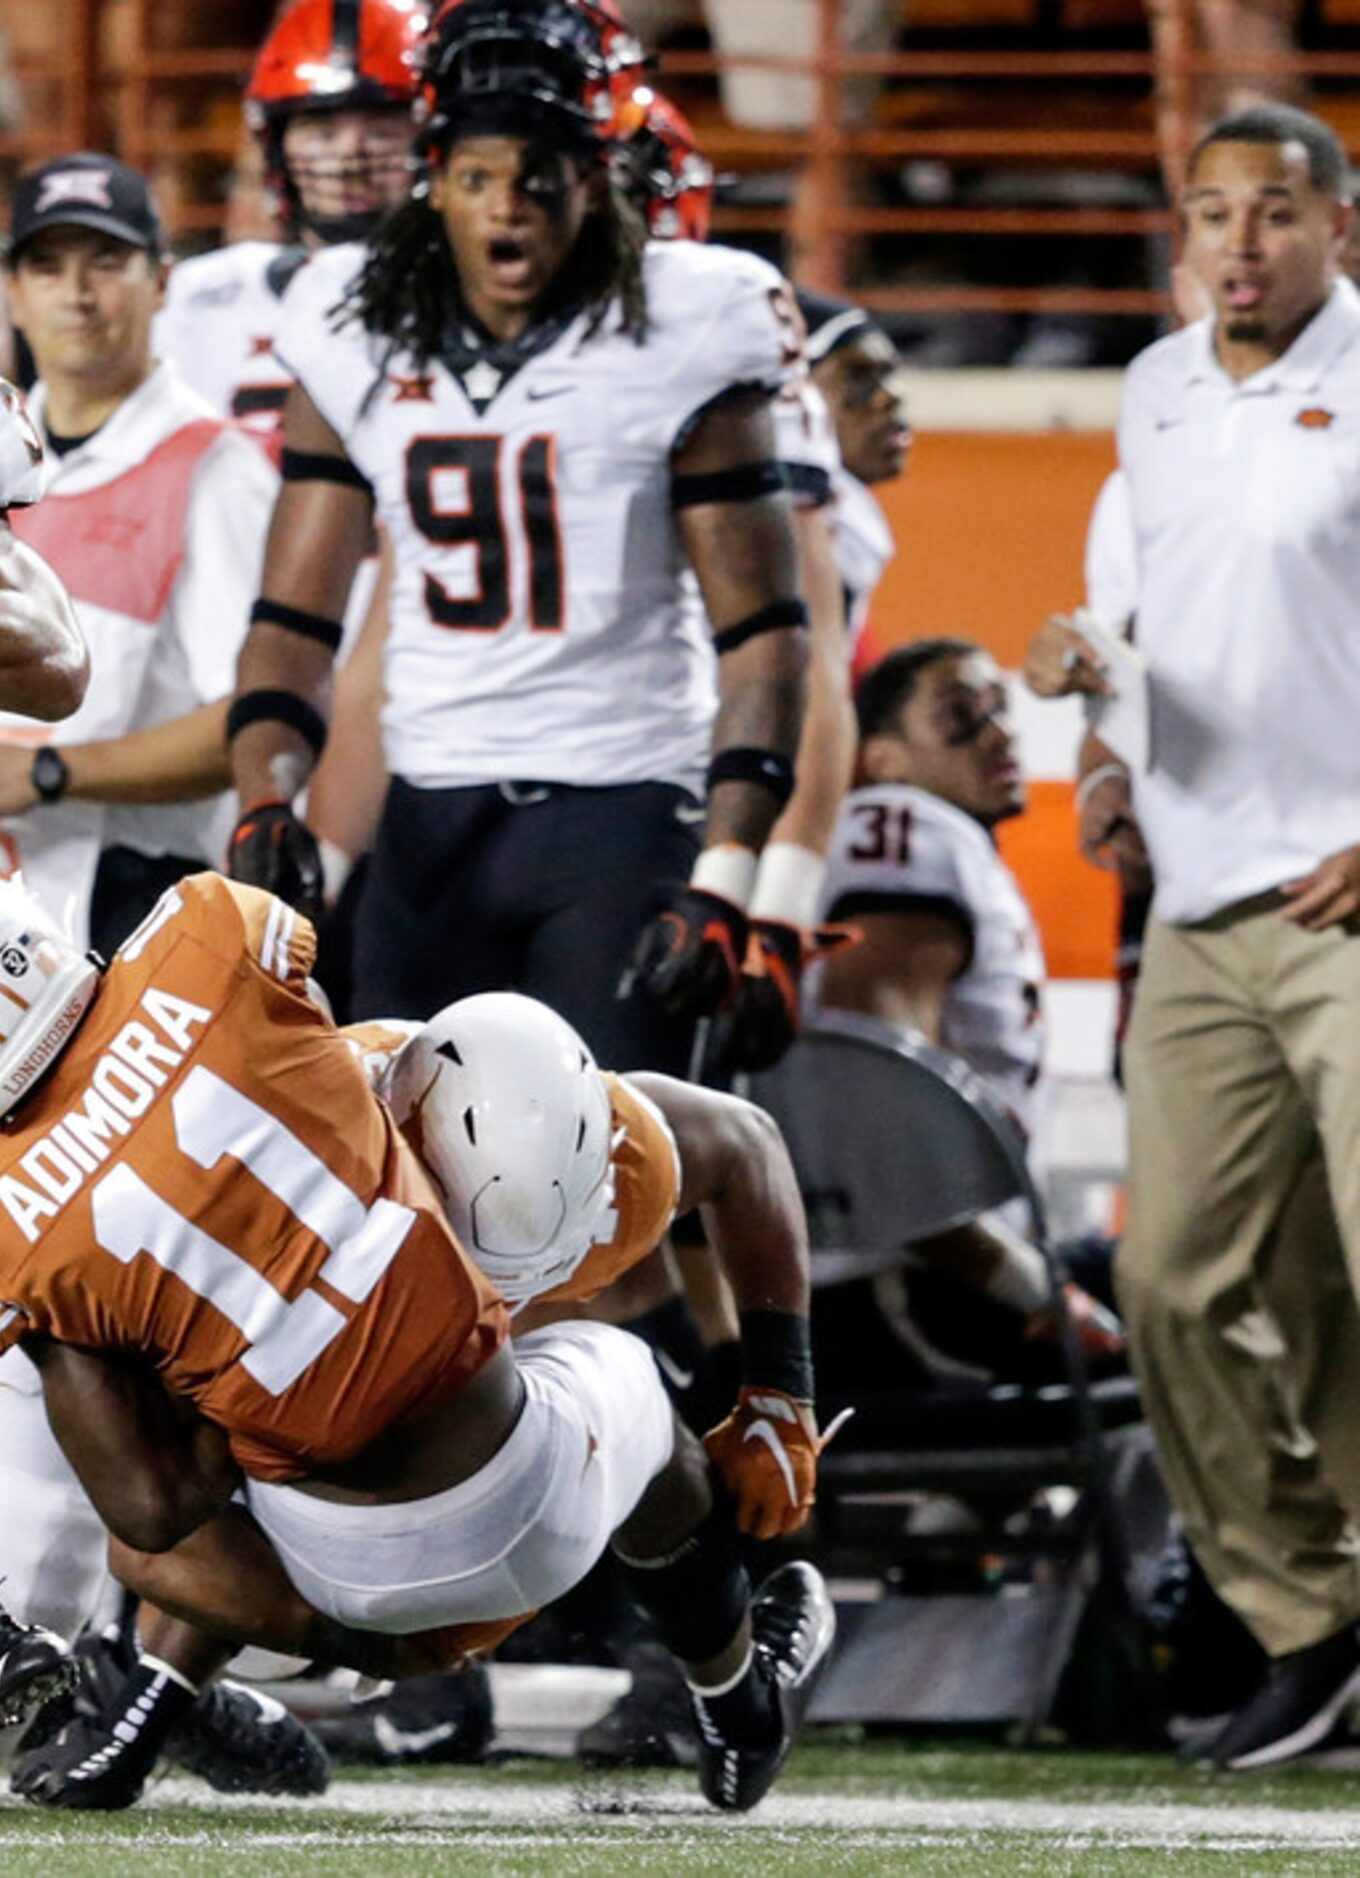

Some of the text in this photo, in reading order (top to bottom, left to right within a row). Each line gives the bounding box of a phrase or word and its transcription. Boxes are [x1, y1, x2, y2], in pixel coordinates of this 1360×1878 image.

[403, 434, 565, 633] 91
[847, 803, 914, 867] 31
[3, 998, 83, 1096] LONGHORNS
[91, 1064, 419, 1397] 11
